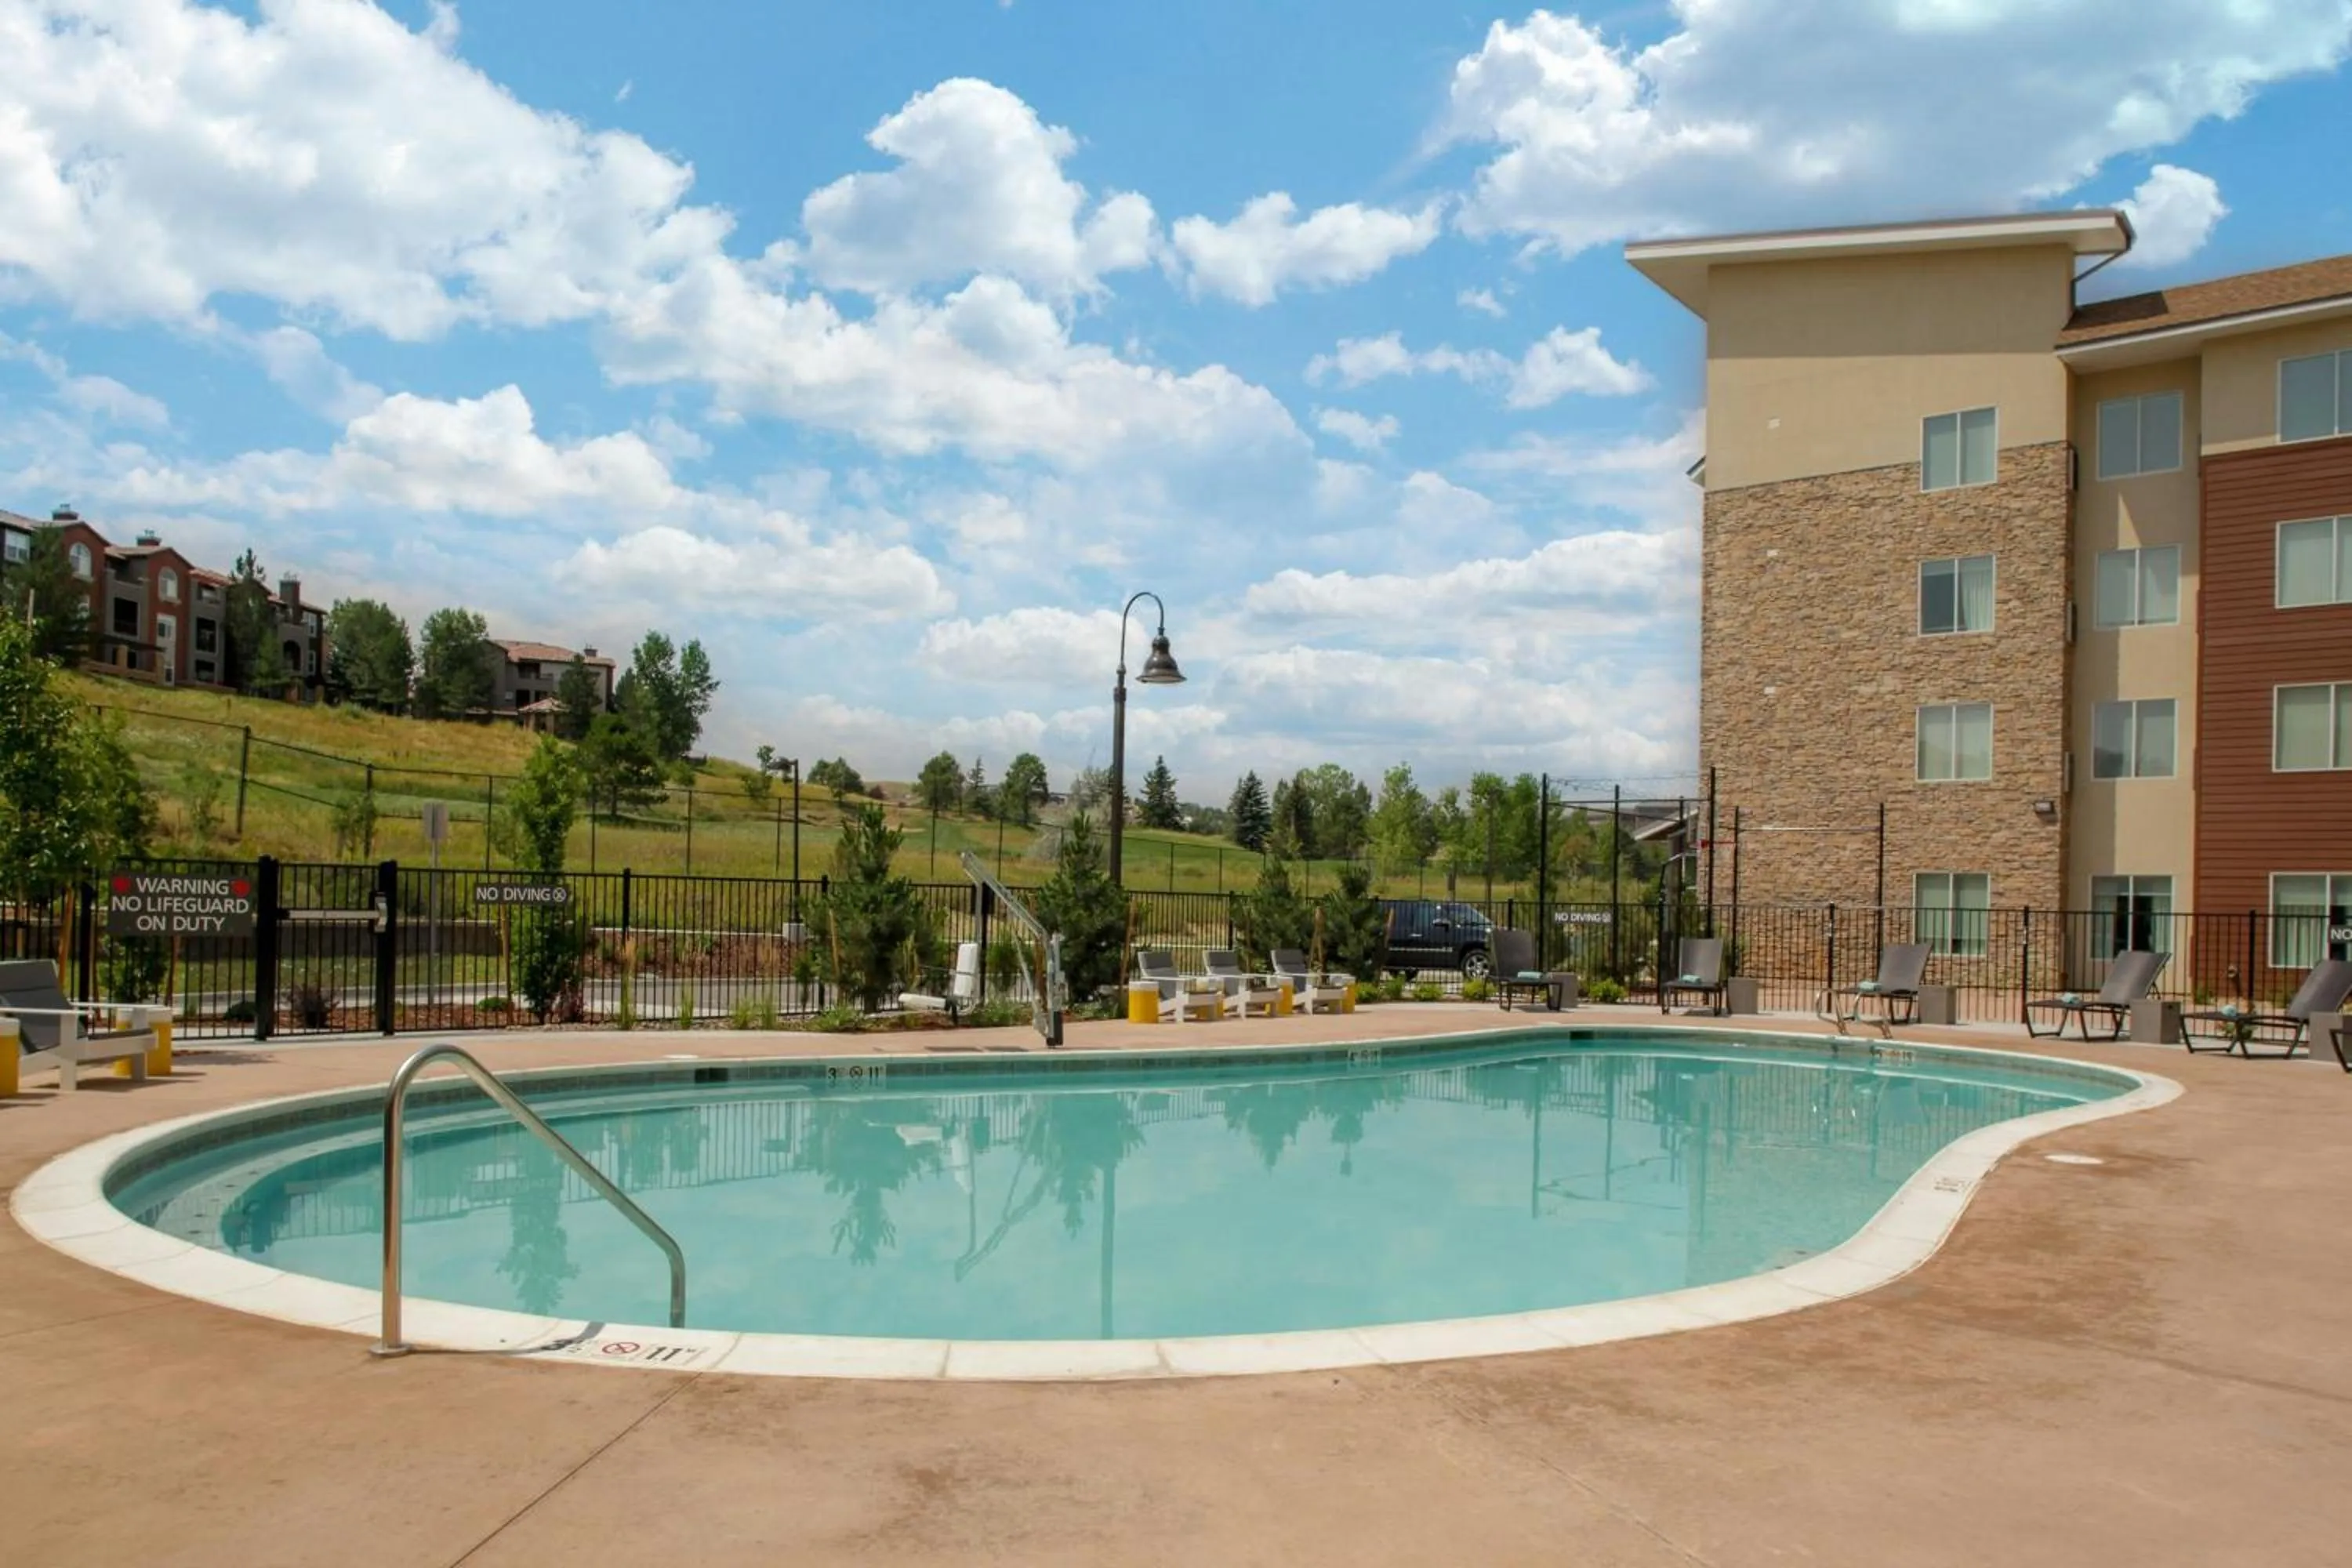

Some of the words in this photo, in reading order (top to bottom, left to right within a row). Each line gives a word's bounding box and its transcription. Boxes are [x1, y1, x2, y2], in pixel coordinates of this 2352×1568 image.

[136, 877, 229, 895] WARNING
[476, 887, 498, 901] NO
[503, 887, 550, 902] DIVING
[111, 896, 142, 912] NO
[147, 897, 249, 913] LIFEGUARD
[136, 915, 166, 931] ON
[172, 916, 226, 932] DUTY
[1555, 912, 1568, 921] NO
[1570, 913, 1601, 923] DIVING
[2331, 928, 2352, 940] NO
